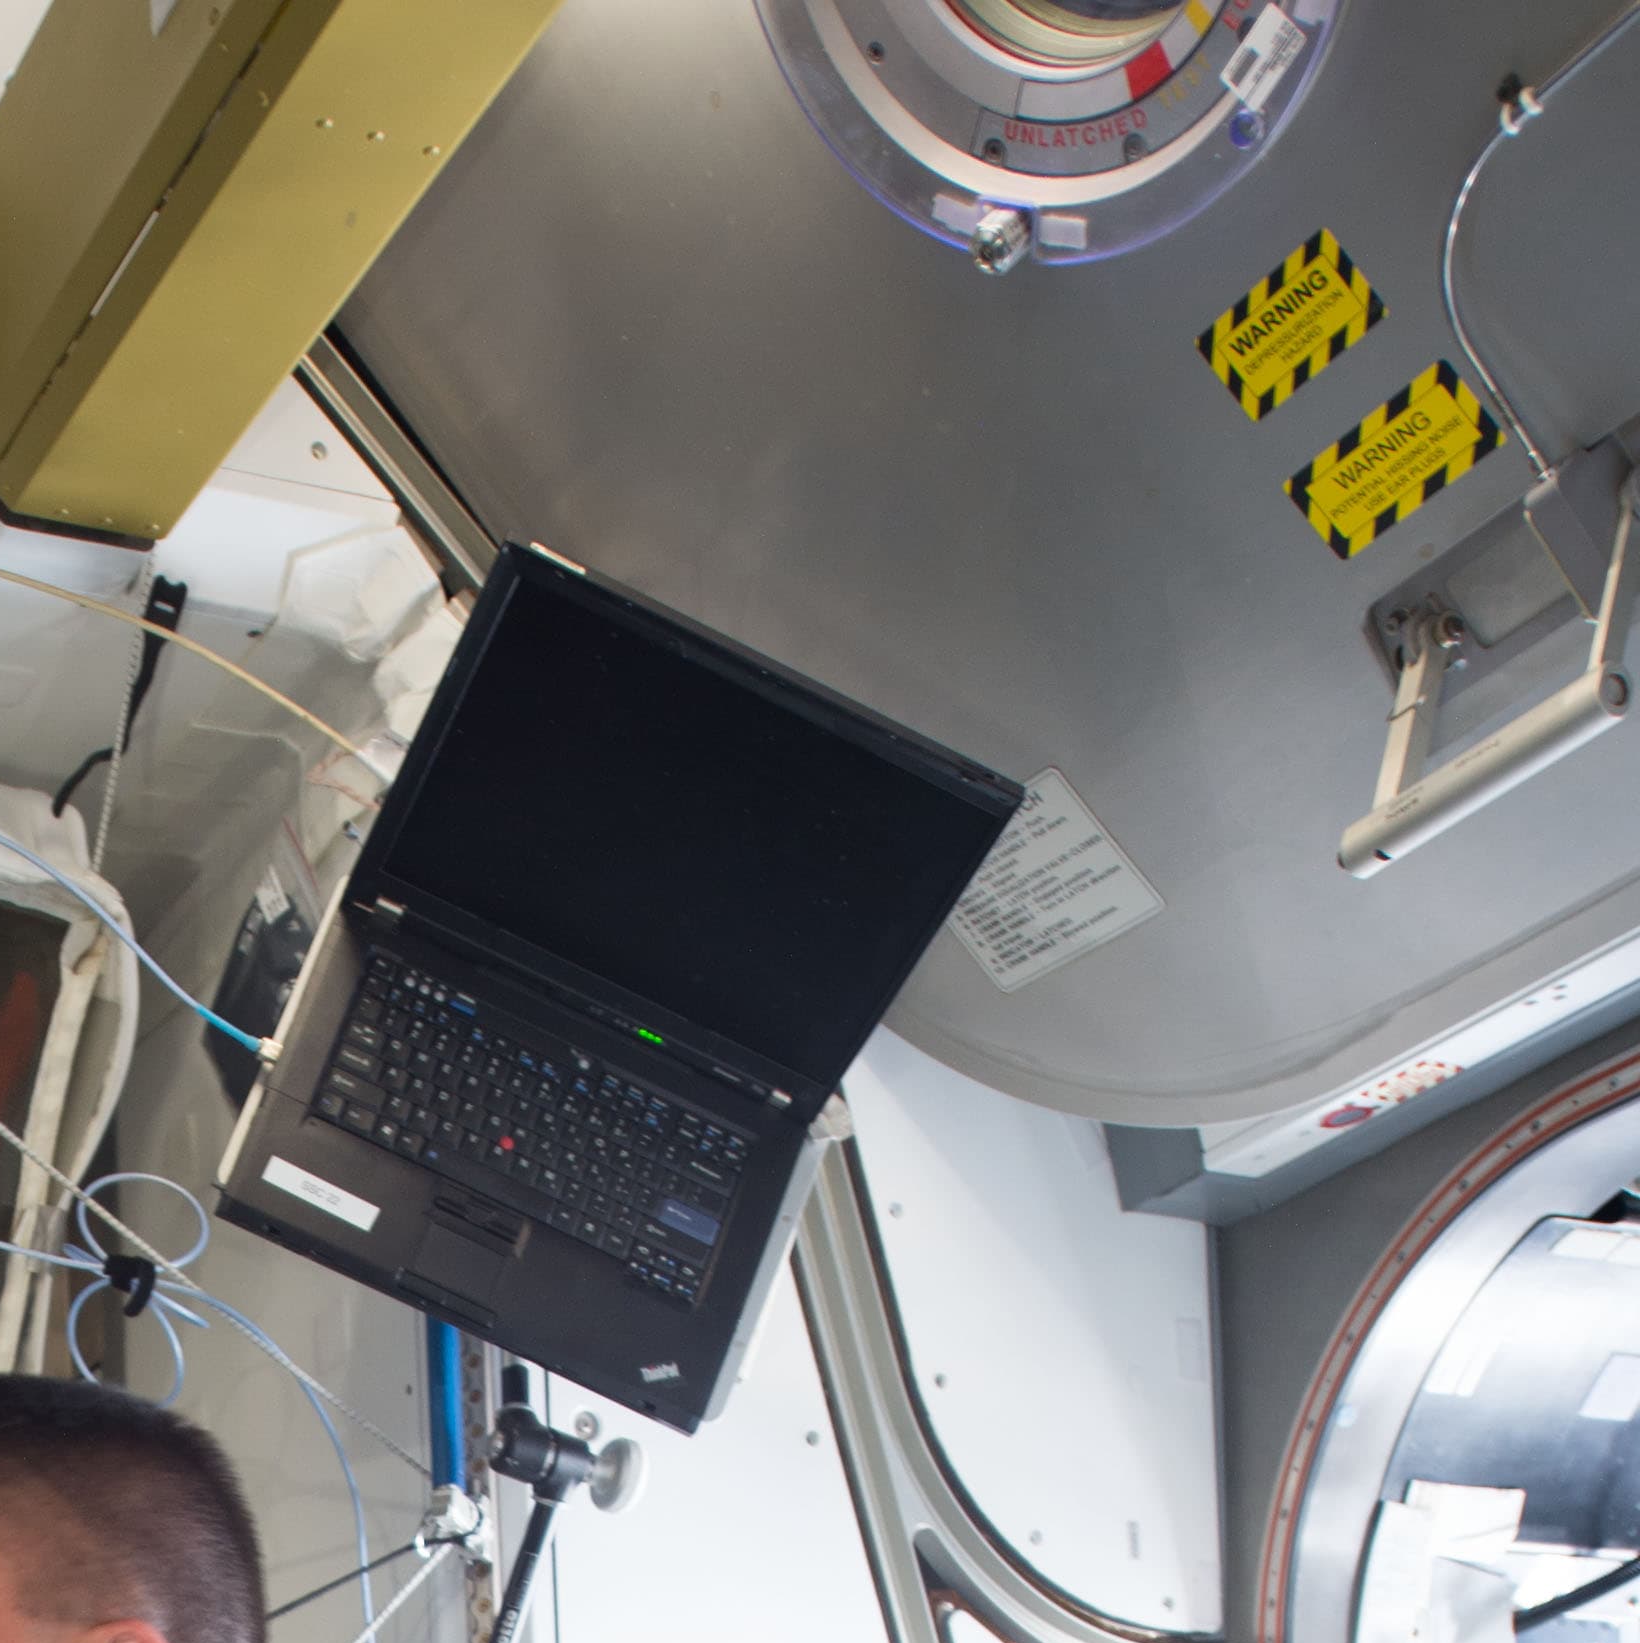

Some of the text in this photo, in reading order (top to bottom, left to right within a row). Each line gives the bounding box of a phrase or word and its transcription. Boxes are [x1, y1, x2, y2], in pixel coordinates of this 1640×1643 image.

[1003, 108, 1148, 148] UNLATCHED
[1229, 270, 1328, 356] WARNING
[1245, 290, 1344, 375] DEPRESSURIZATION
[1281, 325, 1323, 362] HAZARD
[1331, 416, 1463, 518] POTENTIAL HISSING NOISE
[1332, 411, 1432, 491] WARNING
[1364, 447, 1447, 512] USE EAR PLUGS
